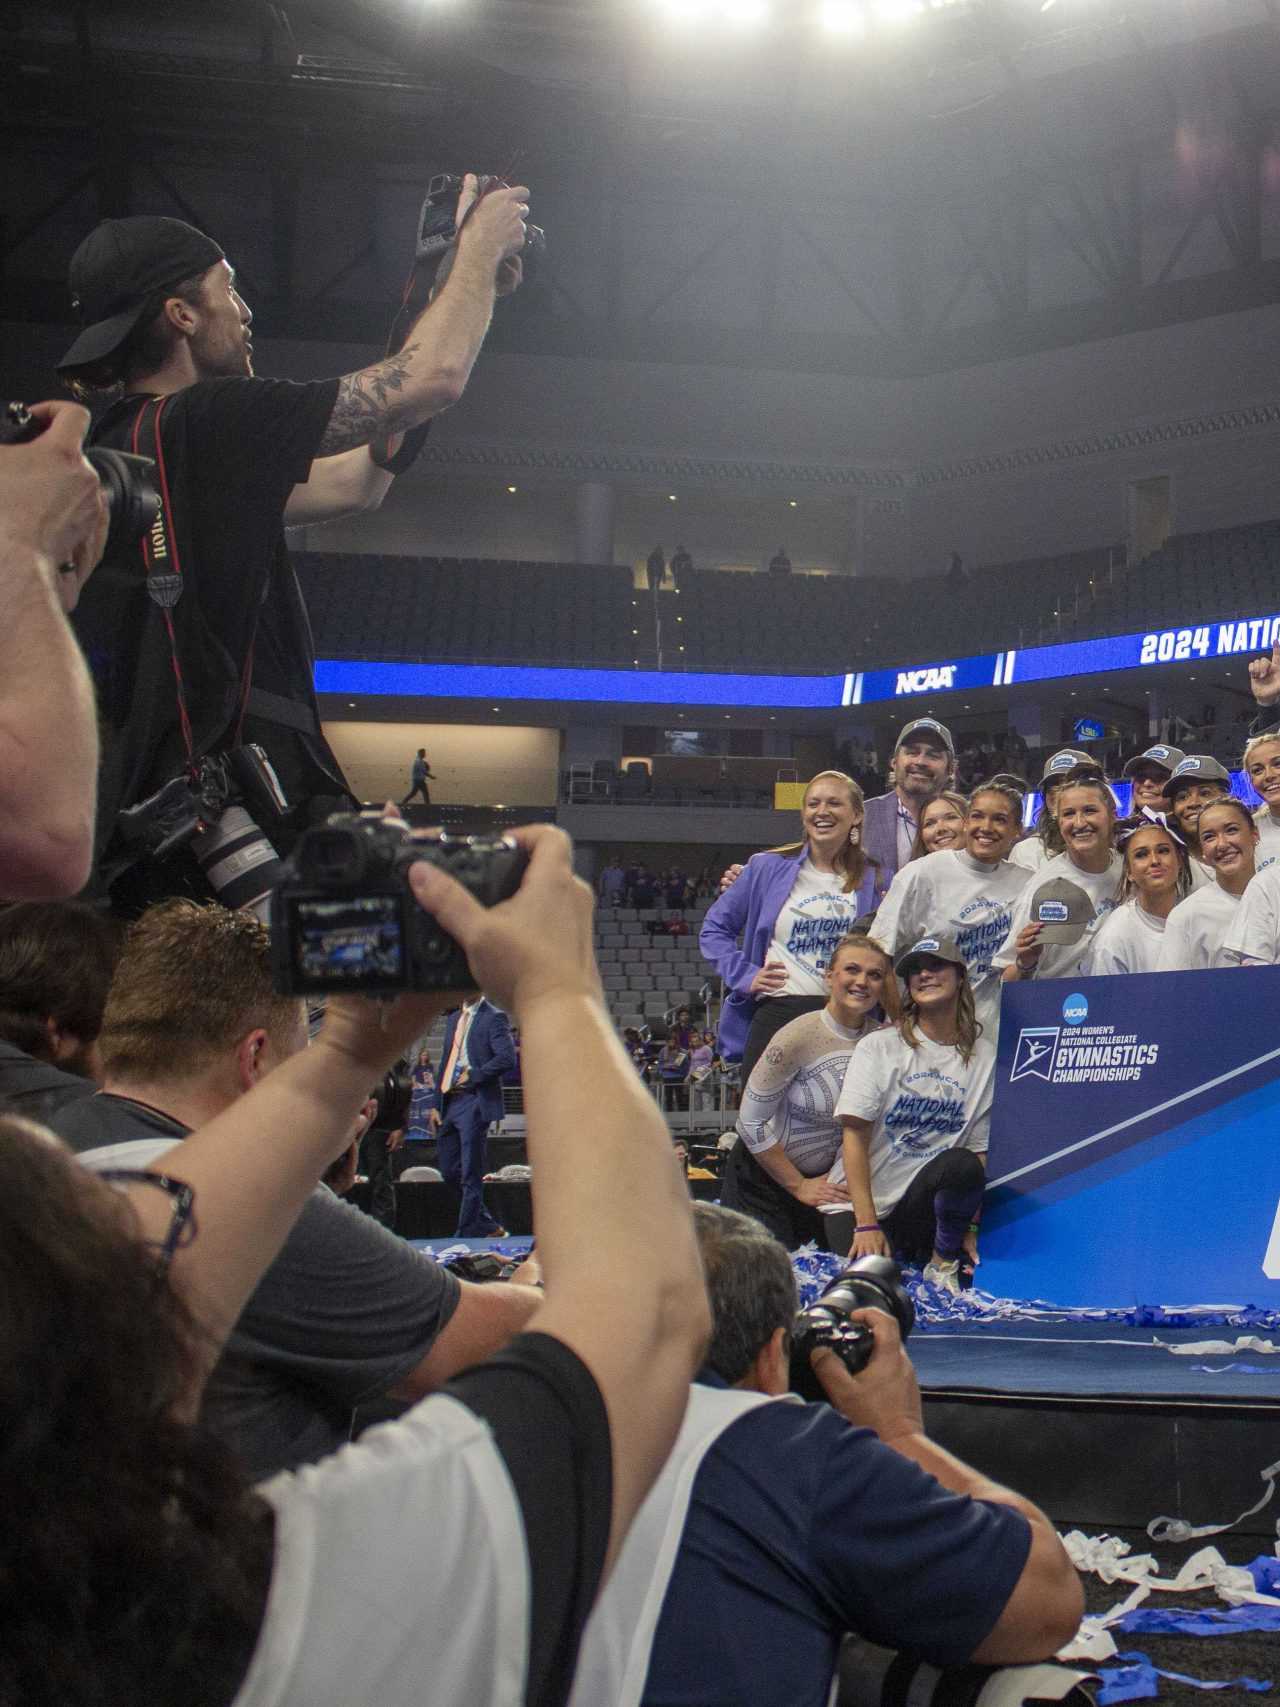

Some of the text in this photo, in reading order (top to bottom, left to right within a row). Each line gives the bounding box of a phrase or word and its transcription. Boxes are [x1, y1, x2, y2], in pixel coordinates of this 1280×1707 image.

[1140, 628, 1211, 664] 2024
[895, 665, 956, 695] NCAA
[1063, 1008, 1088, 1017] NCAA
[1062, 1025, 1114, 1036] 2024 WOMEN'S
[1060, 1035, 1137, 1046] NATIONAL COLLEGIATE
[1056, 1044, 1160, 1067] GYMNASTICS
[1052, 1067, 1142, 1083] CHAMPIONSHIPS
[893, 1094, 966, 1118] NATIONAL
